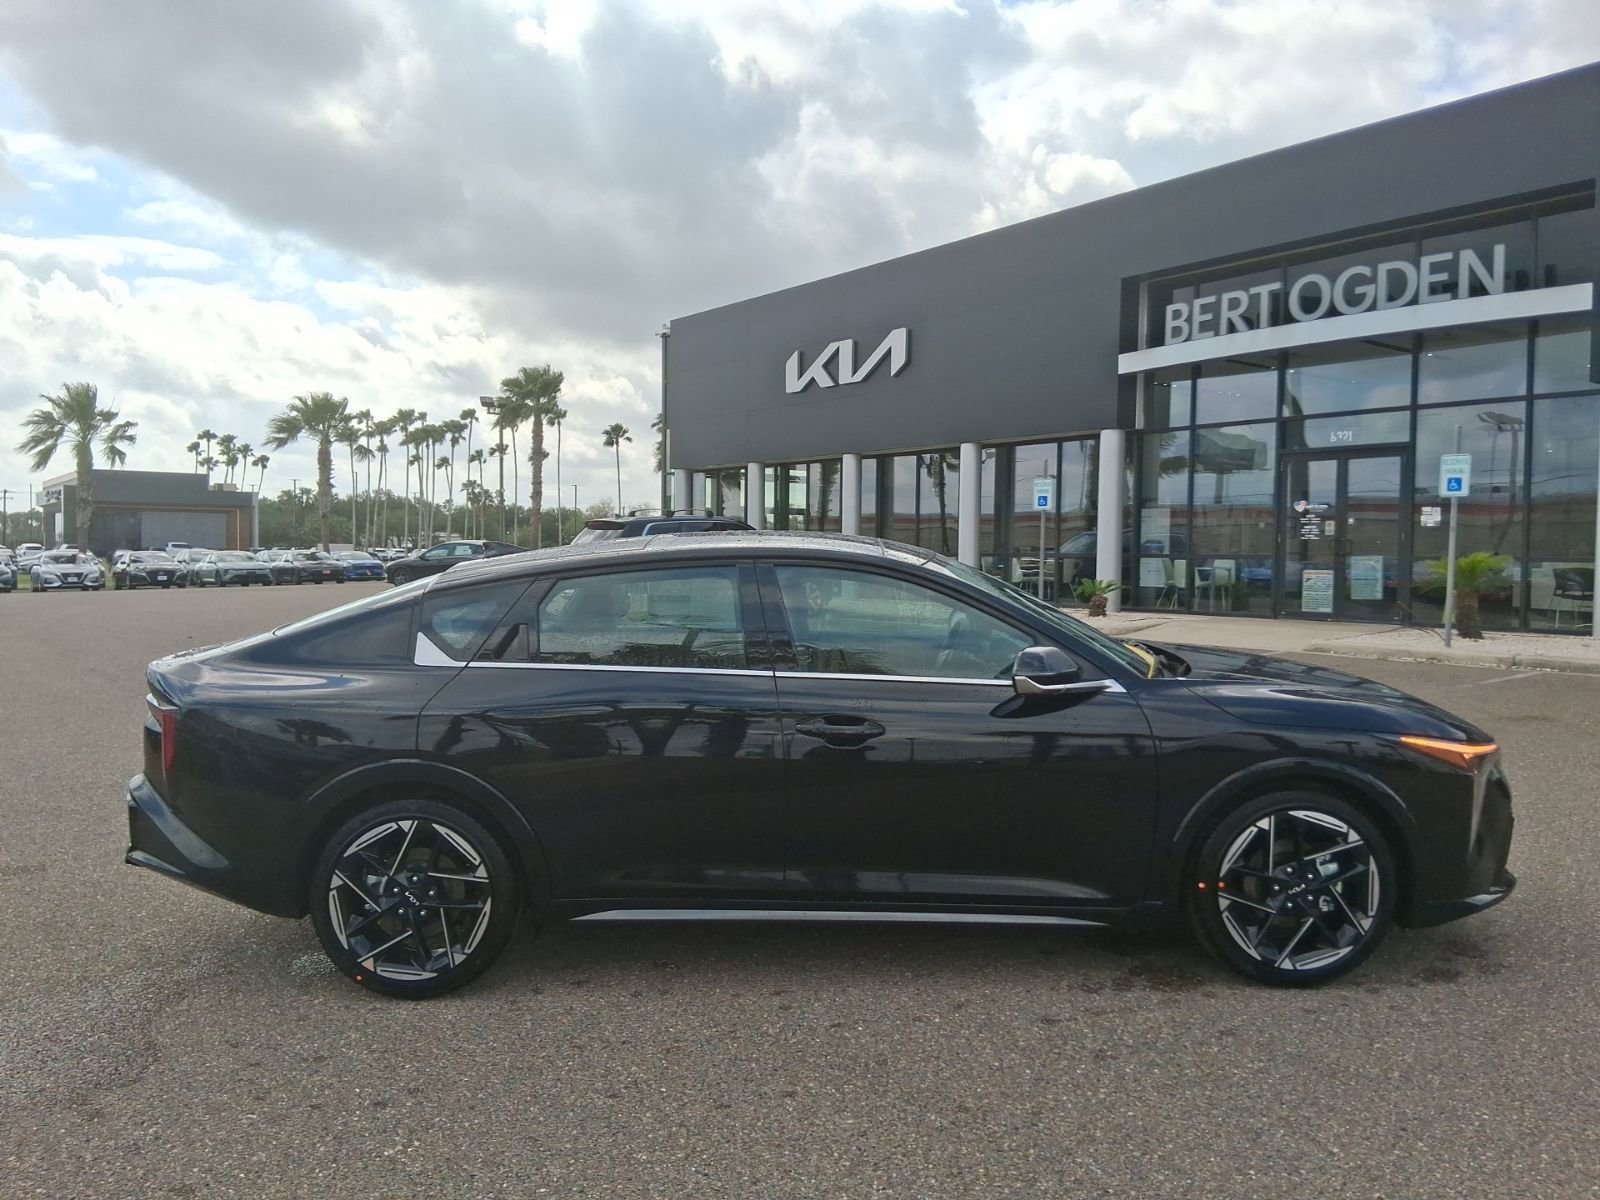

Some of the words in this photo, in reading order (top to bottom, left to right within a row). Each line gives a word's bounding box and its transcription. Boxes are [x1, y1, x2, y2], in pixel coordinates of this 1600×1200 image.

[1164, 281, 1282, 346] BERT
[1288, 243, 1506, 322] OGDEN
[785, 327, 907, 393] KIA
